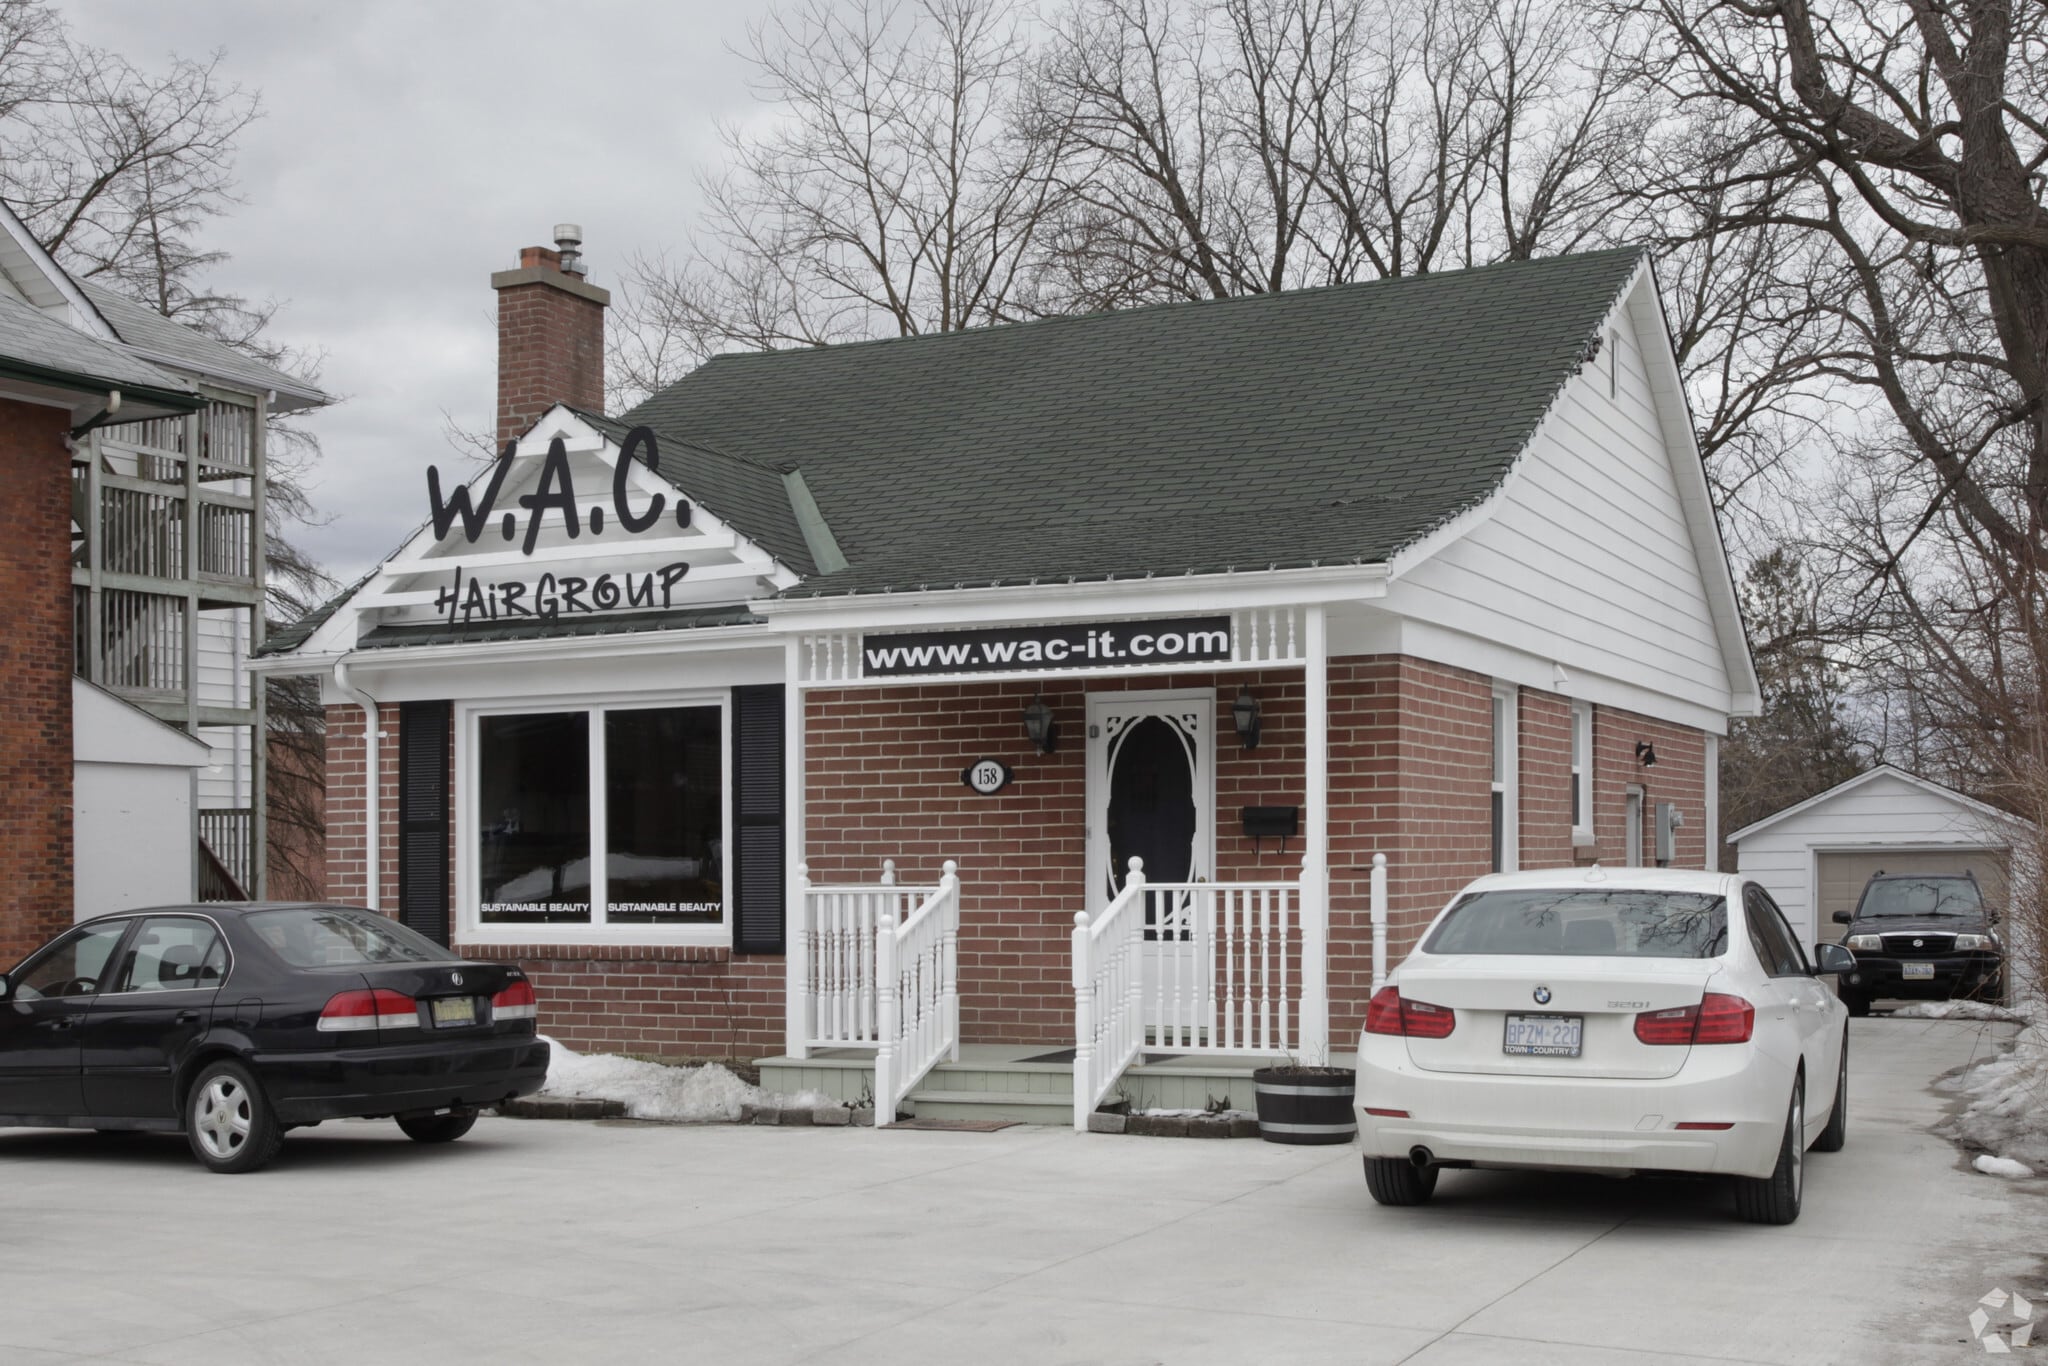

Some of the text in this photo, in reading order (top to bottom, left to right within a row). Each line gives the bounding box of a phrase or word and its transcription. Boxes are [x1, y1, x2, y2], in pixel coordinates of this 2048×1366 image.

[427, 426, 690, 555] W.A.C.
[867, 630, 1227, 669] www.wac-it.com
[978, 767, 997, 784] 158
[481, 903, 589, 912] SUSTAINABLE BEAUTY
[608, 902, 720, 912] SUSTAINABLE BEAUTY
